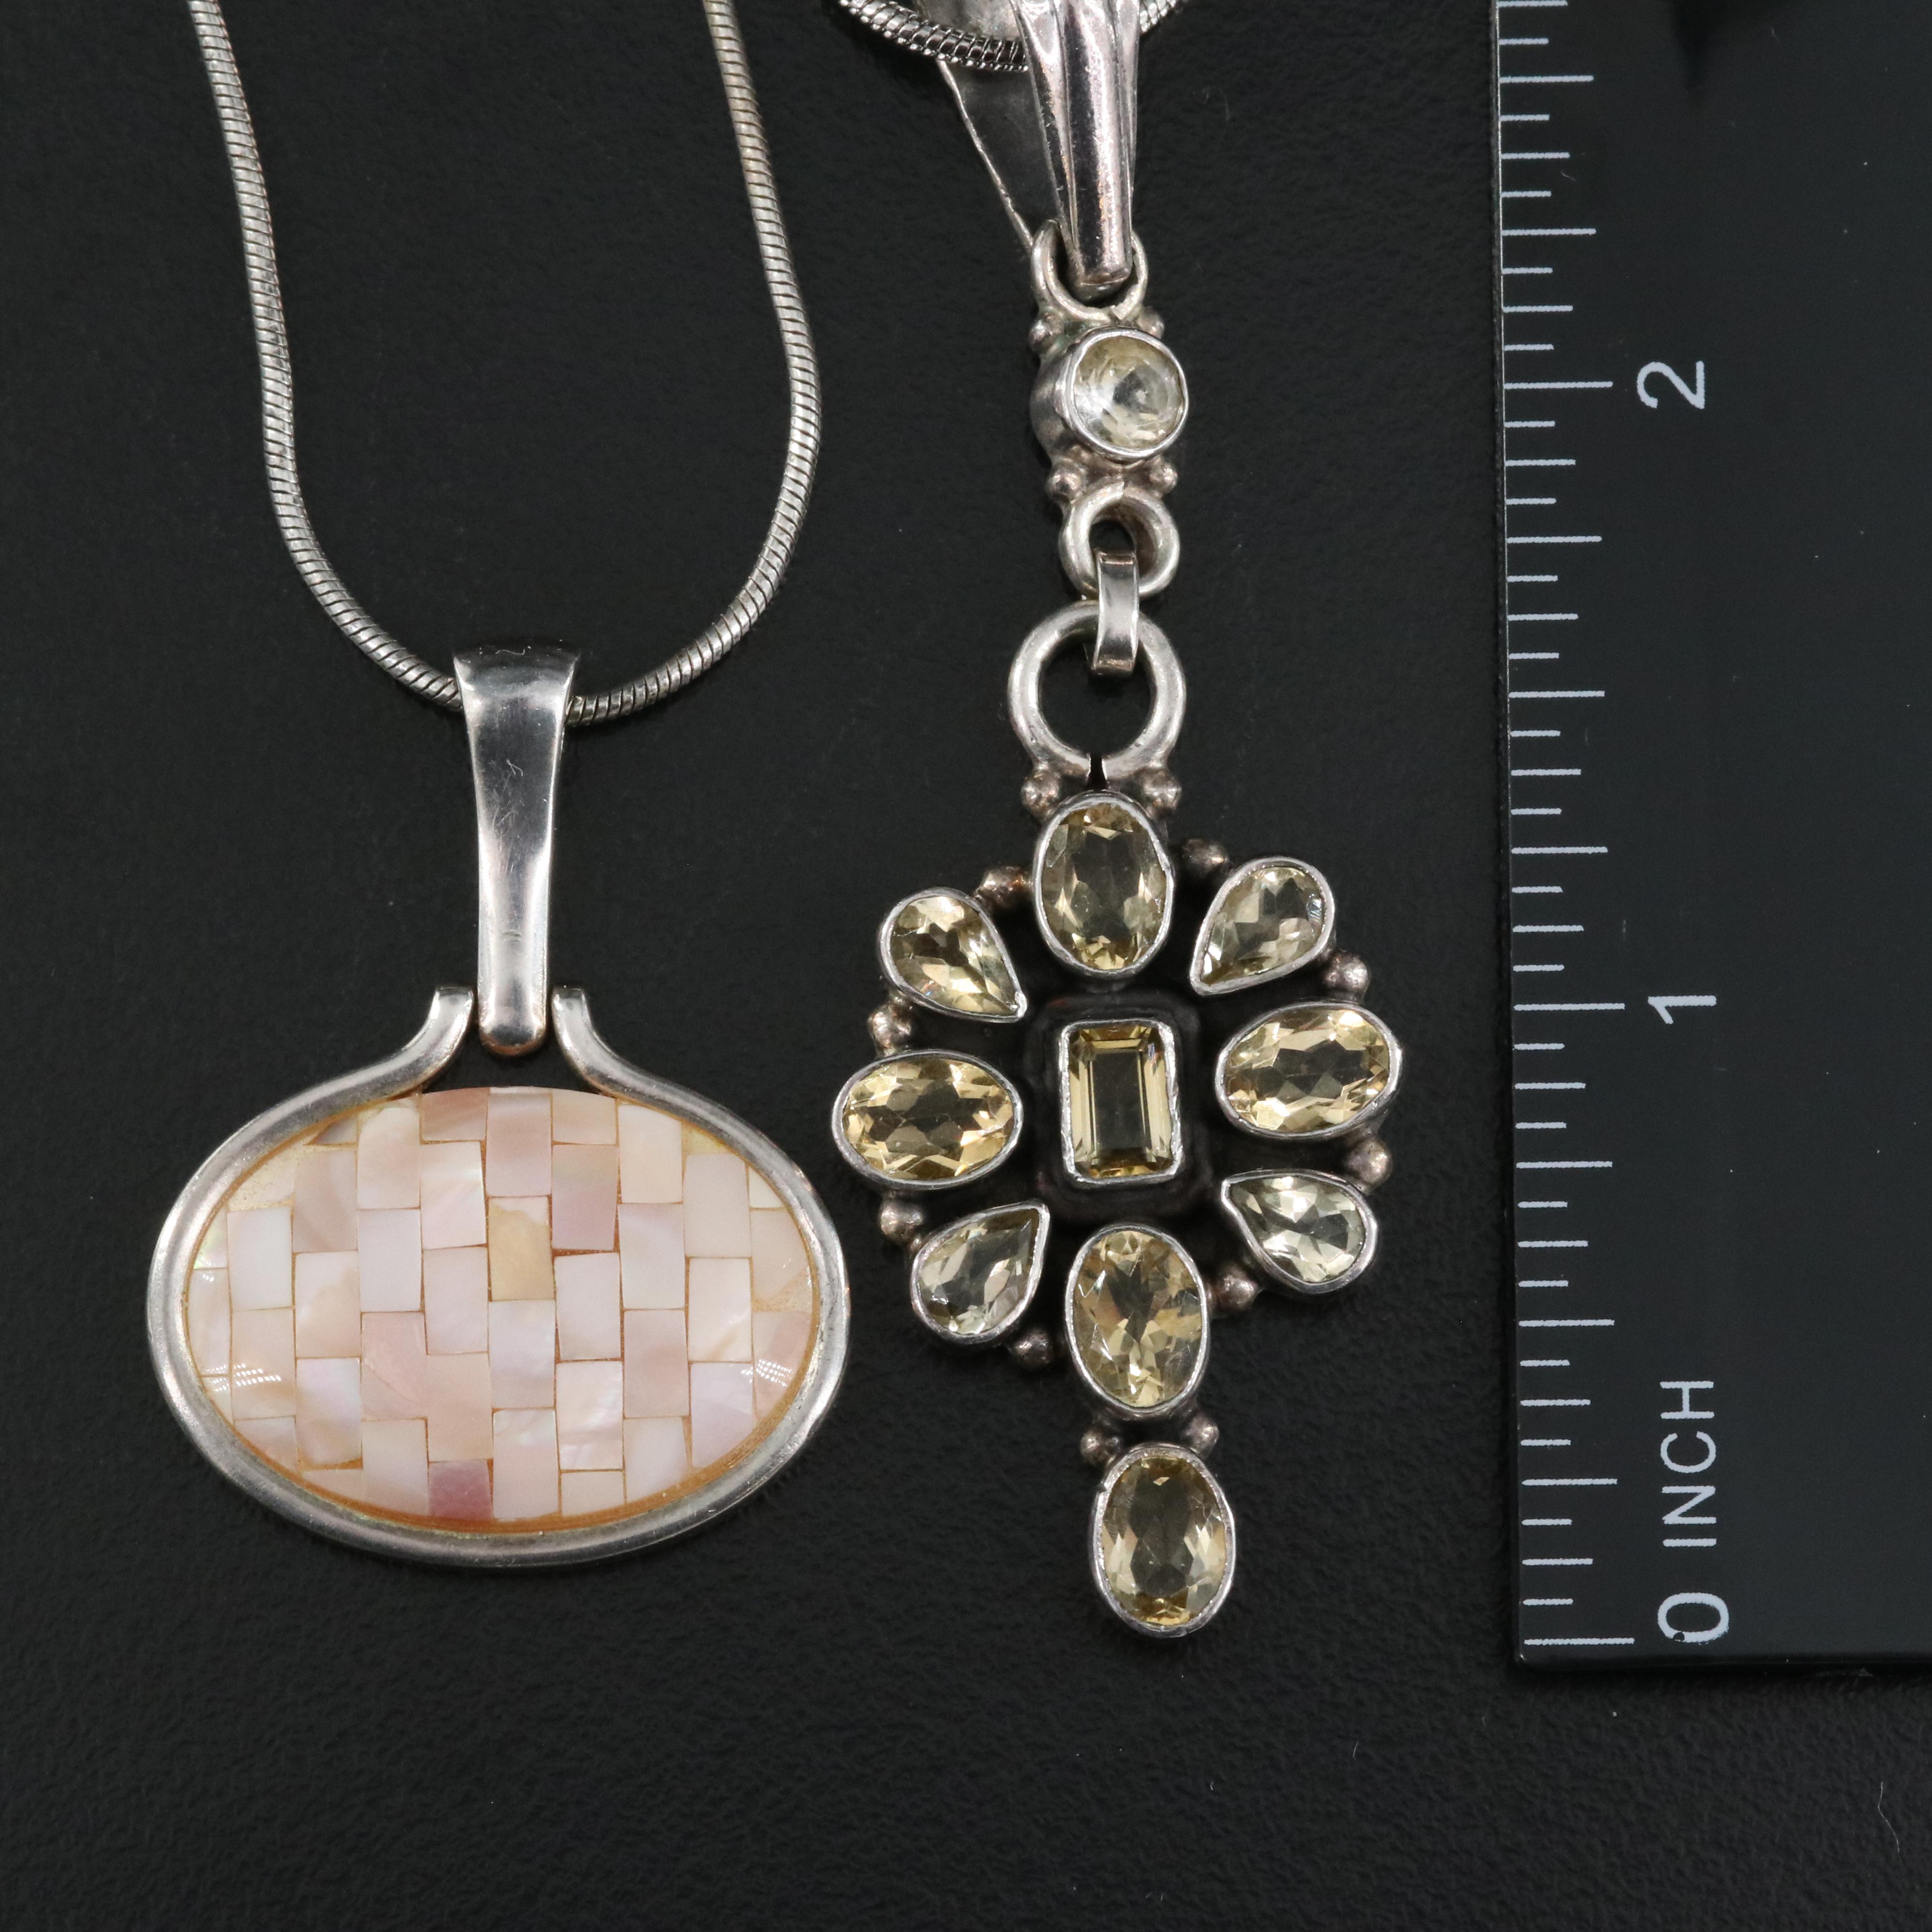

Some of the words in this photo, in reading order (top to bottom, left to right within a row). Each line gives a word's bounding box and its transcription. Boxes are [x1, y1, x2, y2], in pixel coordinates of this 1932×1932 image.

[1636, 360, 1705, 410] 2
[1648, 995, 1717, 1024] 1
[1660, 1380, 1717, 1547] INCH
[1657, 1592, 1730, 1644] 0
